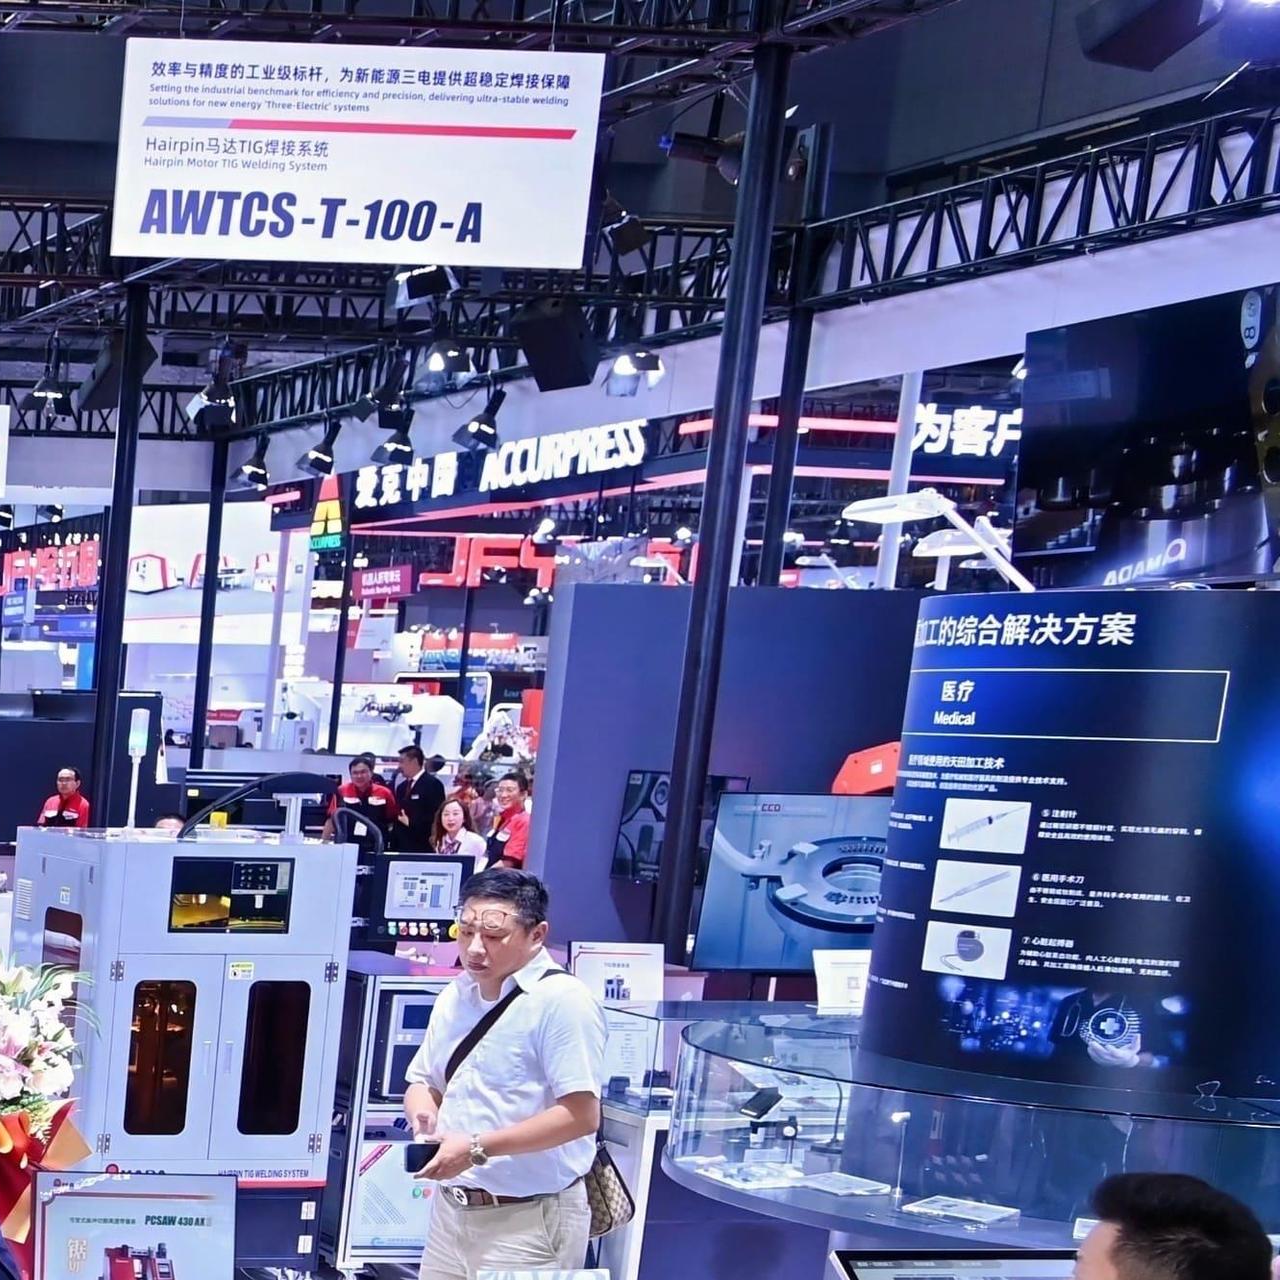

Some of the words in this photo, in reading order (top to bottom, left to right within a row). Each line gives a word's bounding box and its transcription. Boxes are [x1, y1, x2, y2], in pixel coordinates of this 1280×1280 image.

[149, 83, 182, 94] Setting
[185, 84, 199, 94] the
[201, 84, 246, 95] industrial
[247, 85, 299, 96] benchmark
[301, 86, 315, 96] for
[316, 87, 359, 99] efficiency
[362, 90, 379, 99] and
[382, 91, 425, 102] precision,
[428, 91, 474, 104] delivering
[477, 94, 531, 104] ultra-stable
[532, 95, 569, 107] welding
[149, 97, 190, 106] solutions
[192, 97, 206, 107] for
[208, 99, 226, 108] new
[229, 100, 261, 110] energy
[333, 102, 370, 112] systems
[145, 137, 329, 158] Hairpin马达TIG焊接系统
[144, 156, 184, 169] Hairpin
[187, 158, 219, 169] Motor
[222, 158, 238, 169] TIG
[241, 159, 286, 172] Welding
[289, 161, 328, 173] System
[140, 188, 483, 243] AWTCS-T-100-A
[478, 419, 648, 492] ACCURPRESS
[941, 679, 975, 703] 医疗
[933, 711, 976, 726] Medical
[244, 1169, 254, 1178] TIG
[255, 1169, 283, 1178] WELDING
[283, 1169, 309, 1178] SYSTEM
[144, 1214, 177, 1226] PCSAW
[178, 1216, 193, 1226] 430
